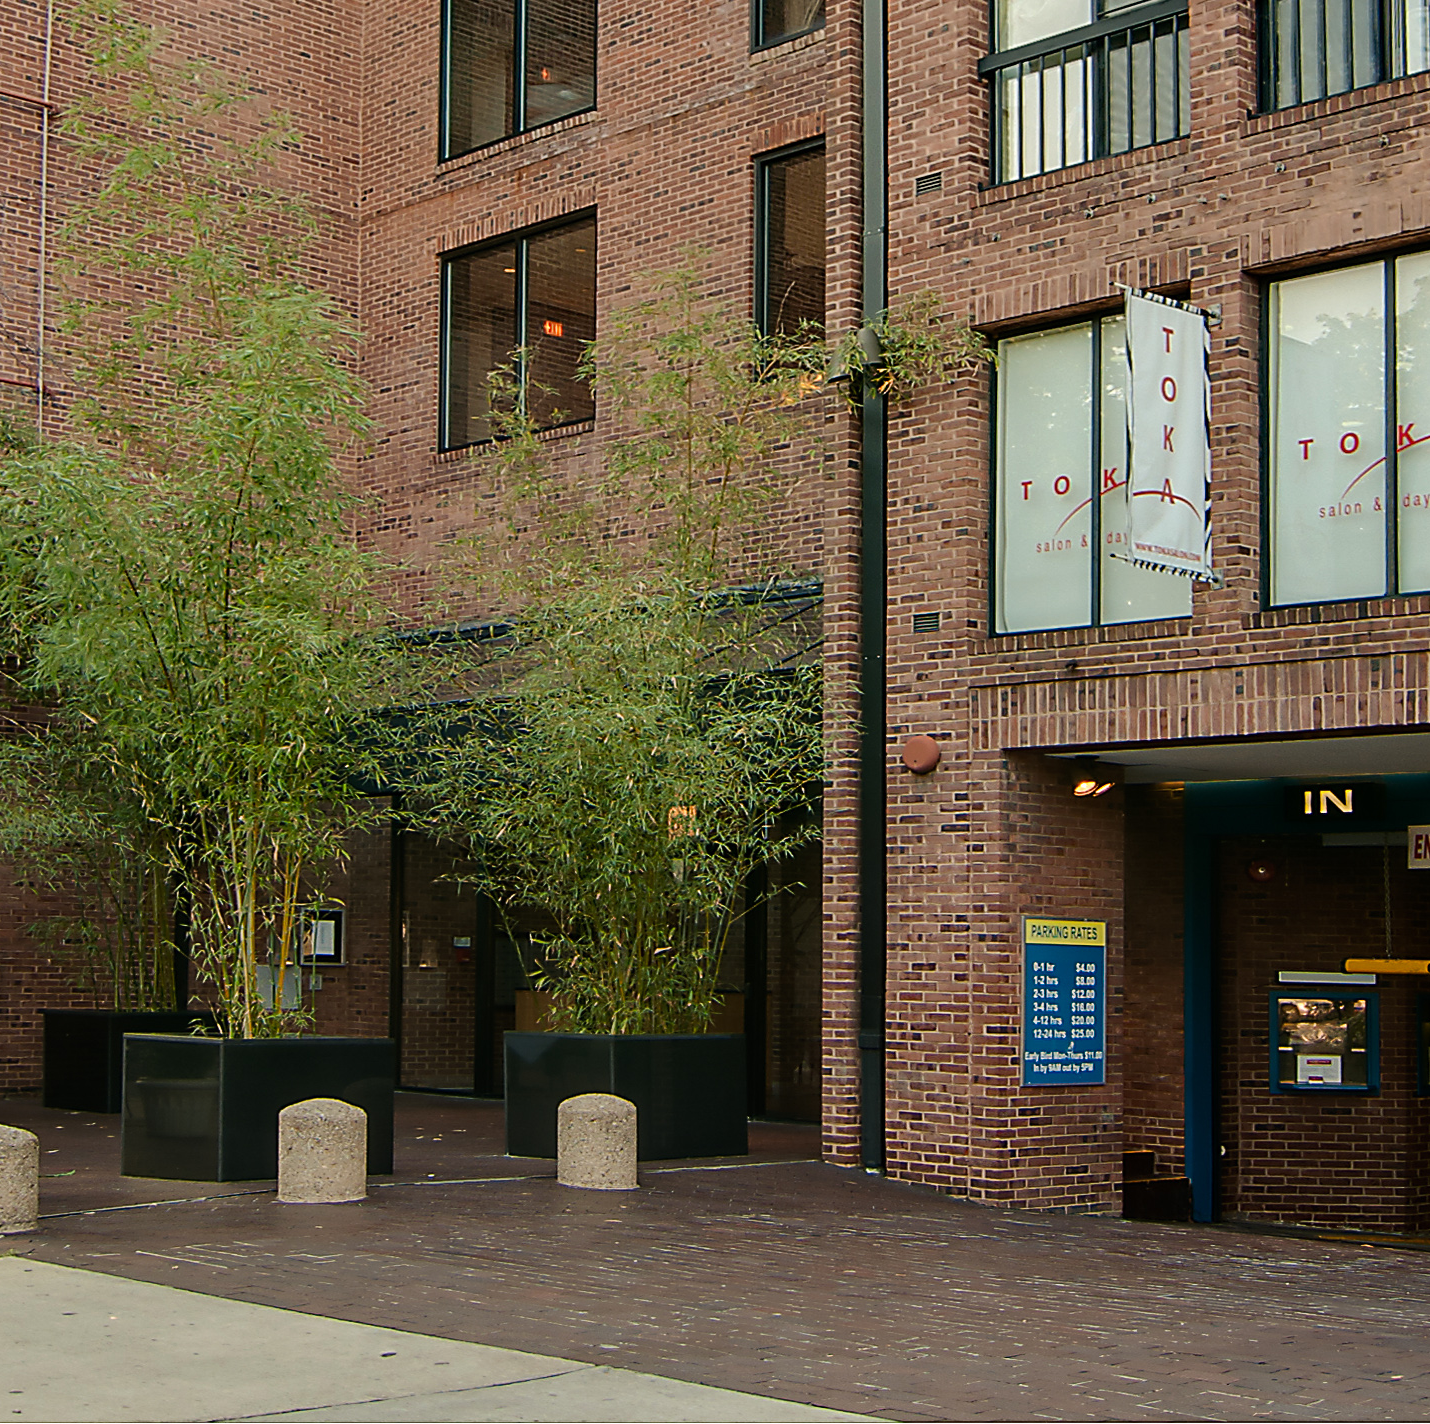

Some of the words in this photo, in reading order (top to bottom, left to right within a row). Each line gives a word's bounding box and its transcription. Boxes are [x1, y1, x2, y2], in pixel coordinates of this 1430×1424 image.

[1161, 327, 1177, 504] TOKA
[1021, 468, 1118, 500] TOK
[1319, 502, 1362, 518] salon
[1373, 497, 1382, 511] &
[1403, 493, 1430, 509] day
[1036, 539, 1071, 553] salon
[1081, 534, 1088, 547] &
[1304, 789, 1353, 814] IN
[1032, 925, 1068, 939] PARKING
[1071, 926, 1097, 940] RATES
[1033, 962, 1044, 972] 0-1
[1046, 962, 1055, 971] hr
[1076, 963, 1095, 973] $4.00
[1033, 976, 1044, 985] 1-2
[1046, 976, 1058, 985] hrs
[1033, 989, 1044, 998] 2-3
[1046, 989, 1058, 998] hrs
[1071, 989, 1095, 999] $12.00
[1033, 1002, 1044, 1011] 3-4
[1046, 1002, 1058, 1011] hrs
[1033, 1015, 1048, 1025] 4-12
[1050, 1016, 1062, 1025] hrs
[1071, 1015, 1094, 1025] $20.00
[1033, 1029, 1052, 1038] 12-24
[1054, 1029, 1066, 1038] hrs
[1071, 1029, 1094, 1038] $25.00
